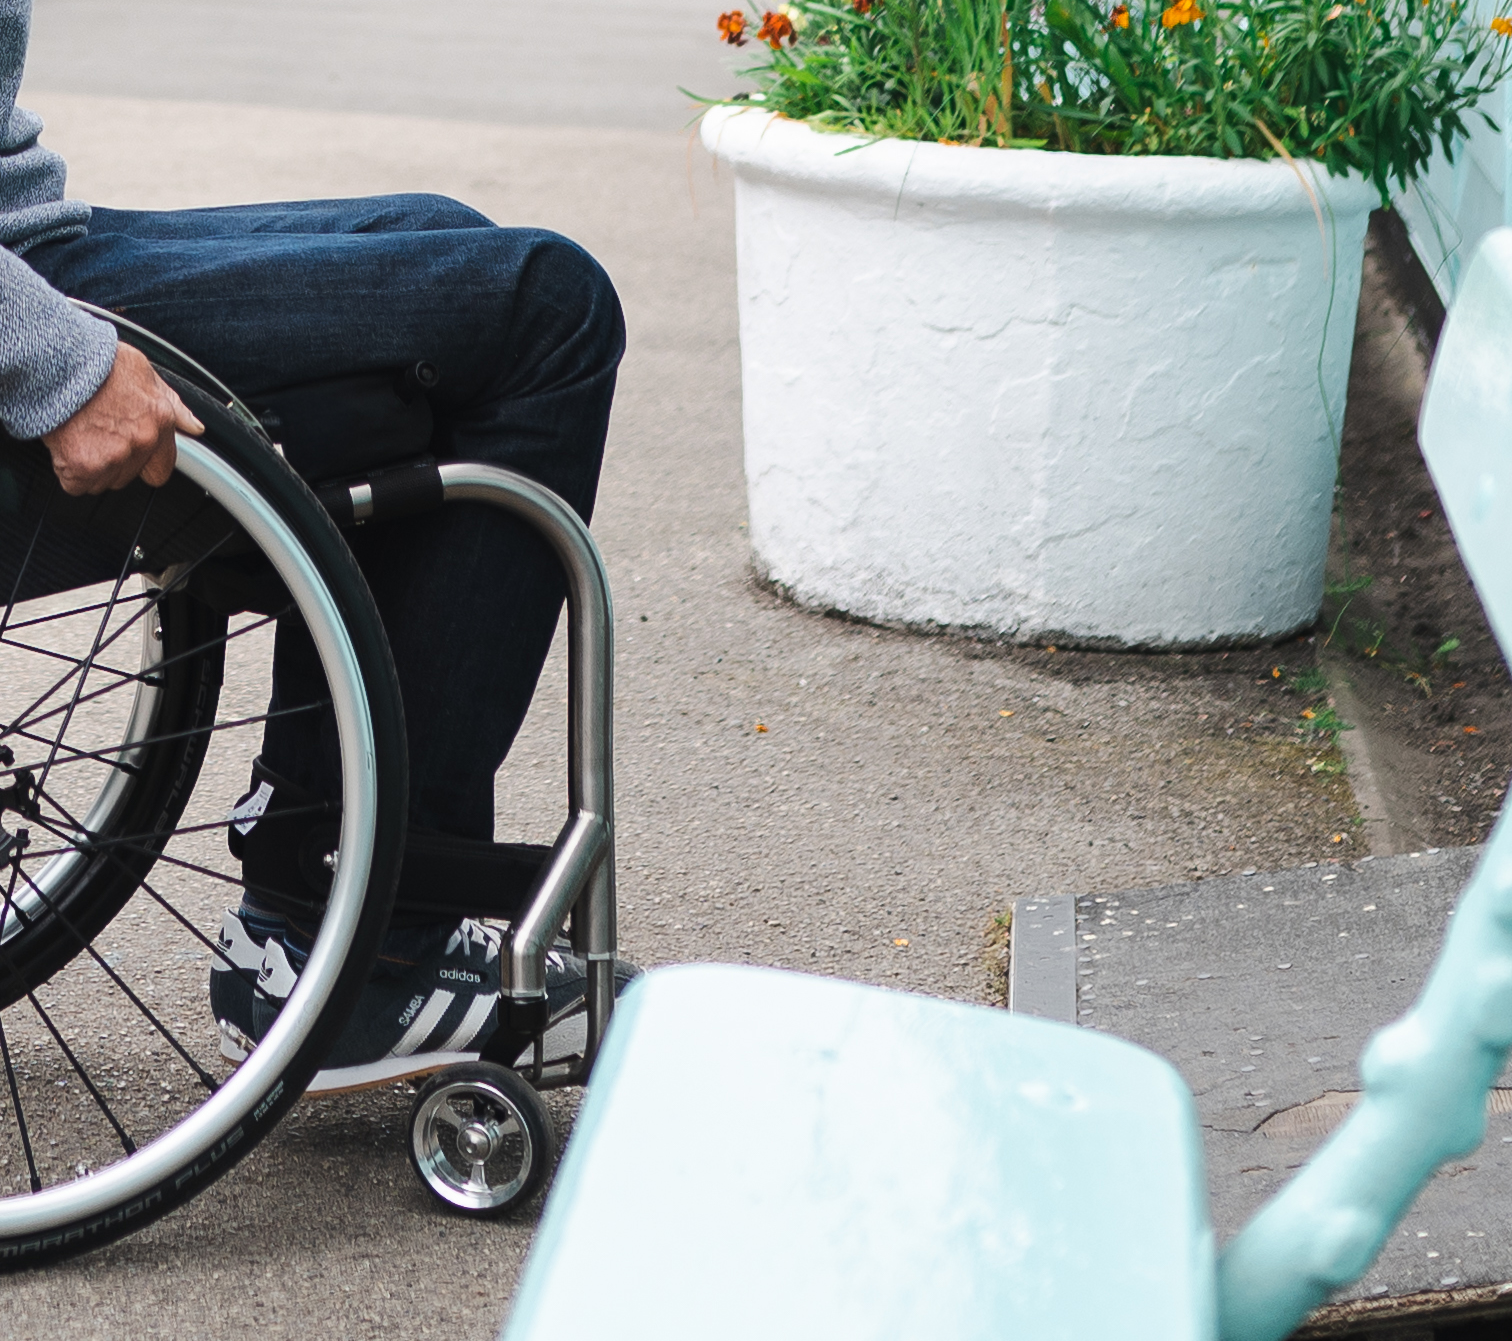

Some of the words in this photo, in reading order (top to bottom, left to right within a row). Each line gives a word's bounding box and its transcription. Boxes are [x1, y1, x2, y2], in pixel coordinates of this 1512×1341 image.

[439, 968, 481, 983] adidas
[398, 994, 425, 1027] SAMBA
[176, 1125, 245, 1190] PLUS
